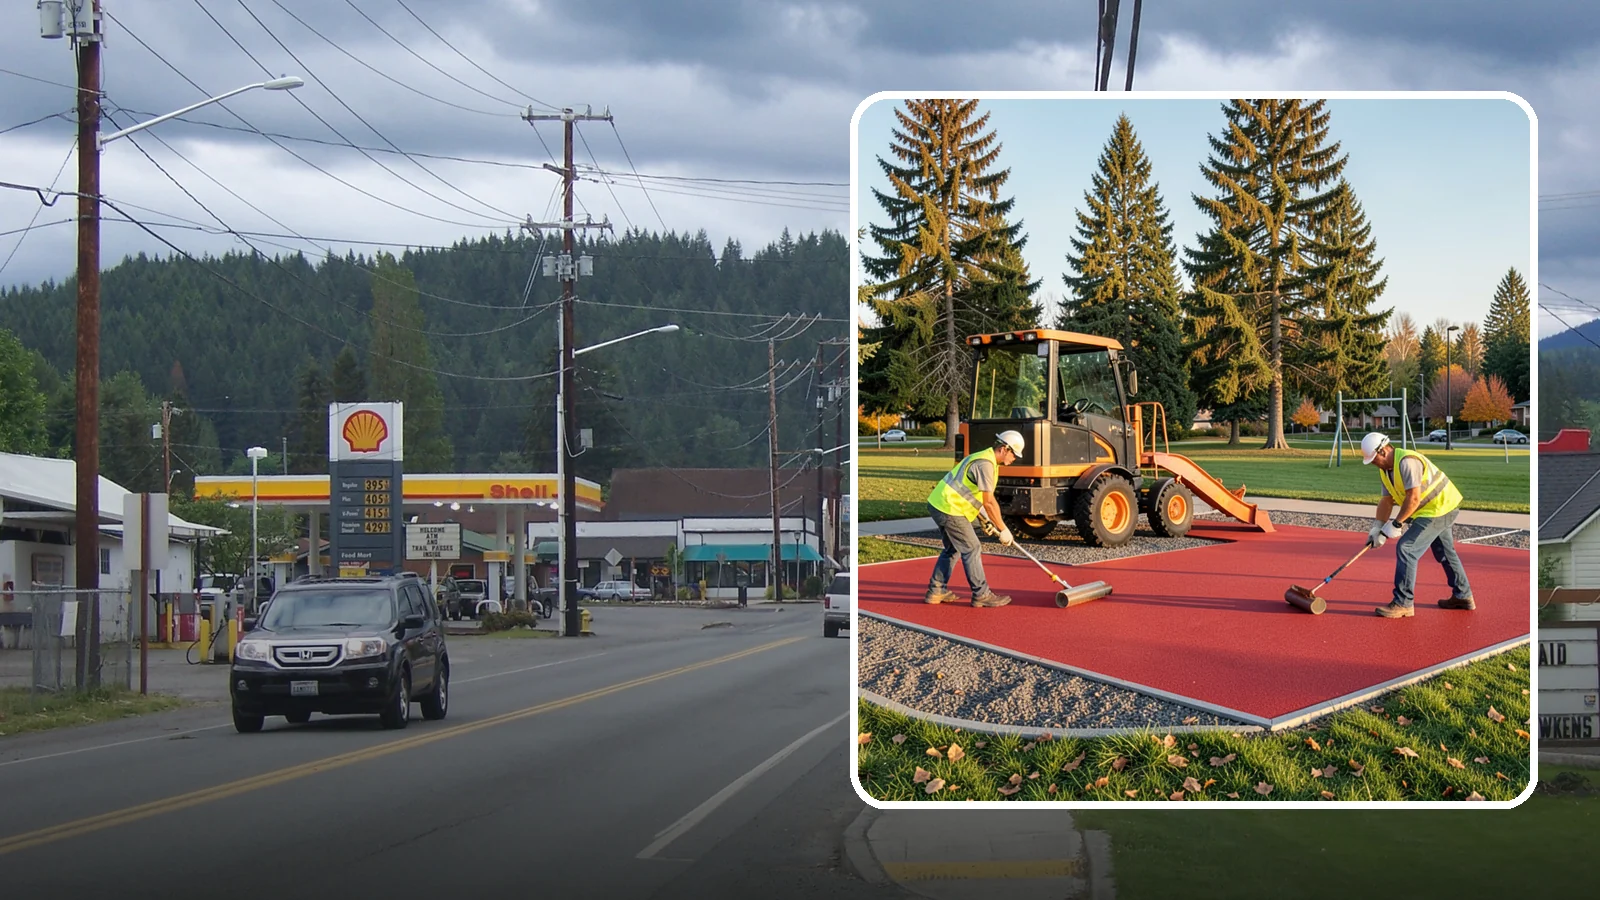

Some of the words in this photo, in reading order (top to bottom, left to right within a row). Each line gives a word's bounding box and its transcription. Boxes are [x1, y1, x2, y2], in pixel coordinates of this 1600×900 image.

[366, 480, 383, 490] 395
[490, 484, 547, 499] Shell
[366, 494, 383, 504] 405
[366, 508, 383, 518] 415
[366, 522, 383, 532] 429
